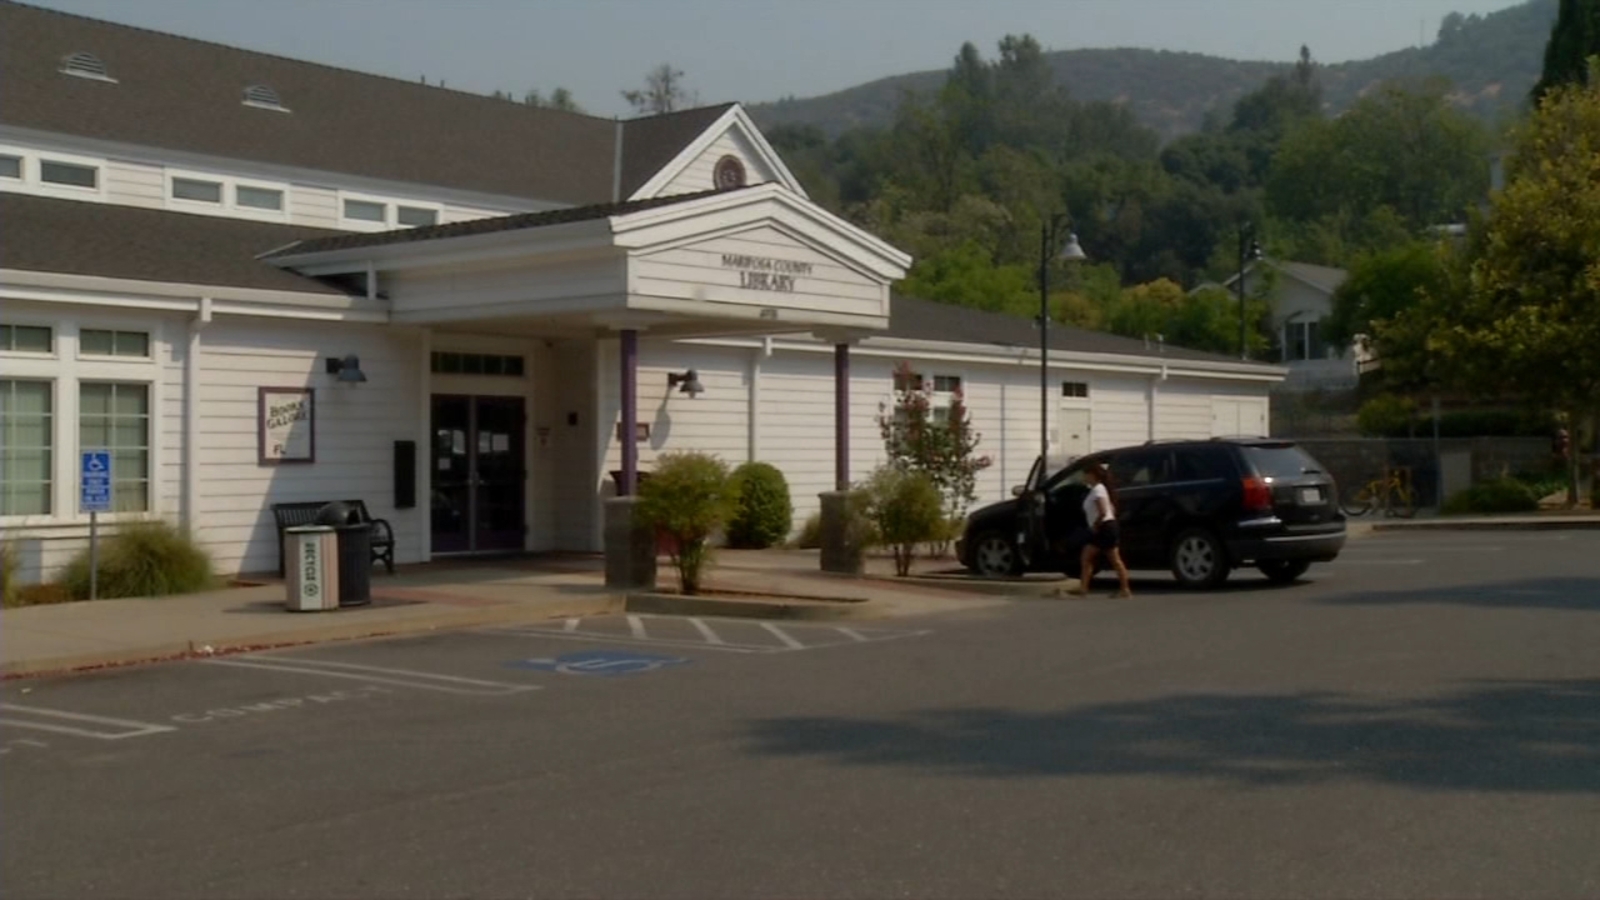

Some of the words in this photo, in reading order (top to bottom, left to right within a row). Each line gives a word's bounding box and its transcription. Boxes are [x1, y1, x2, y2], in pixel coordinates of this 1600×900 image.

[721, 253, 772, 270] MARIPOSA
[774, 259, 812, 275] COUNTY
[740, 270, 795, 292] LIBRARY
[305, 542, 316, 581] RECYCLE
